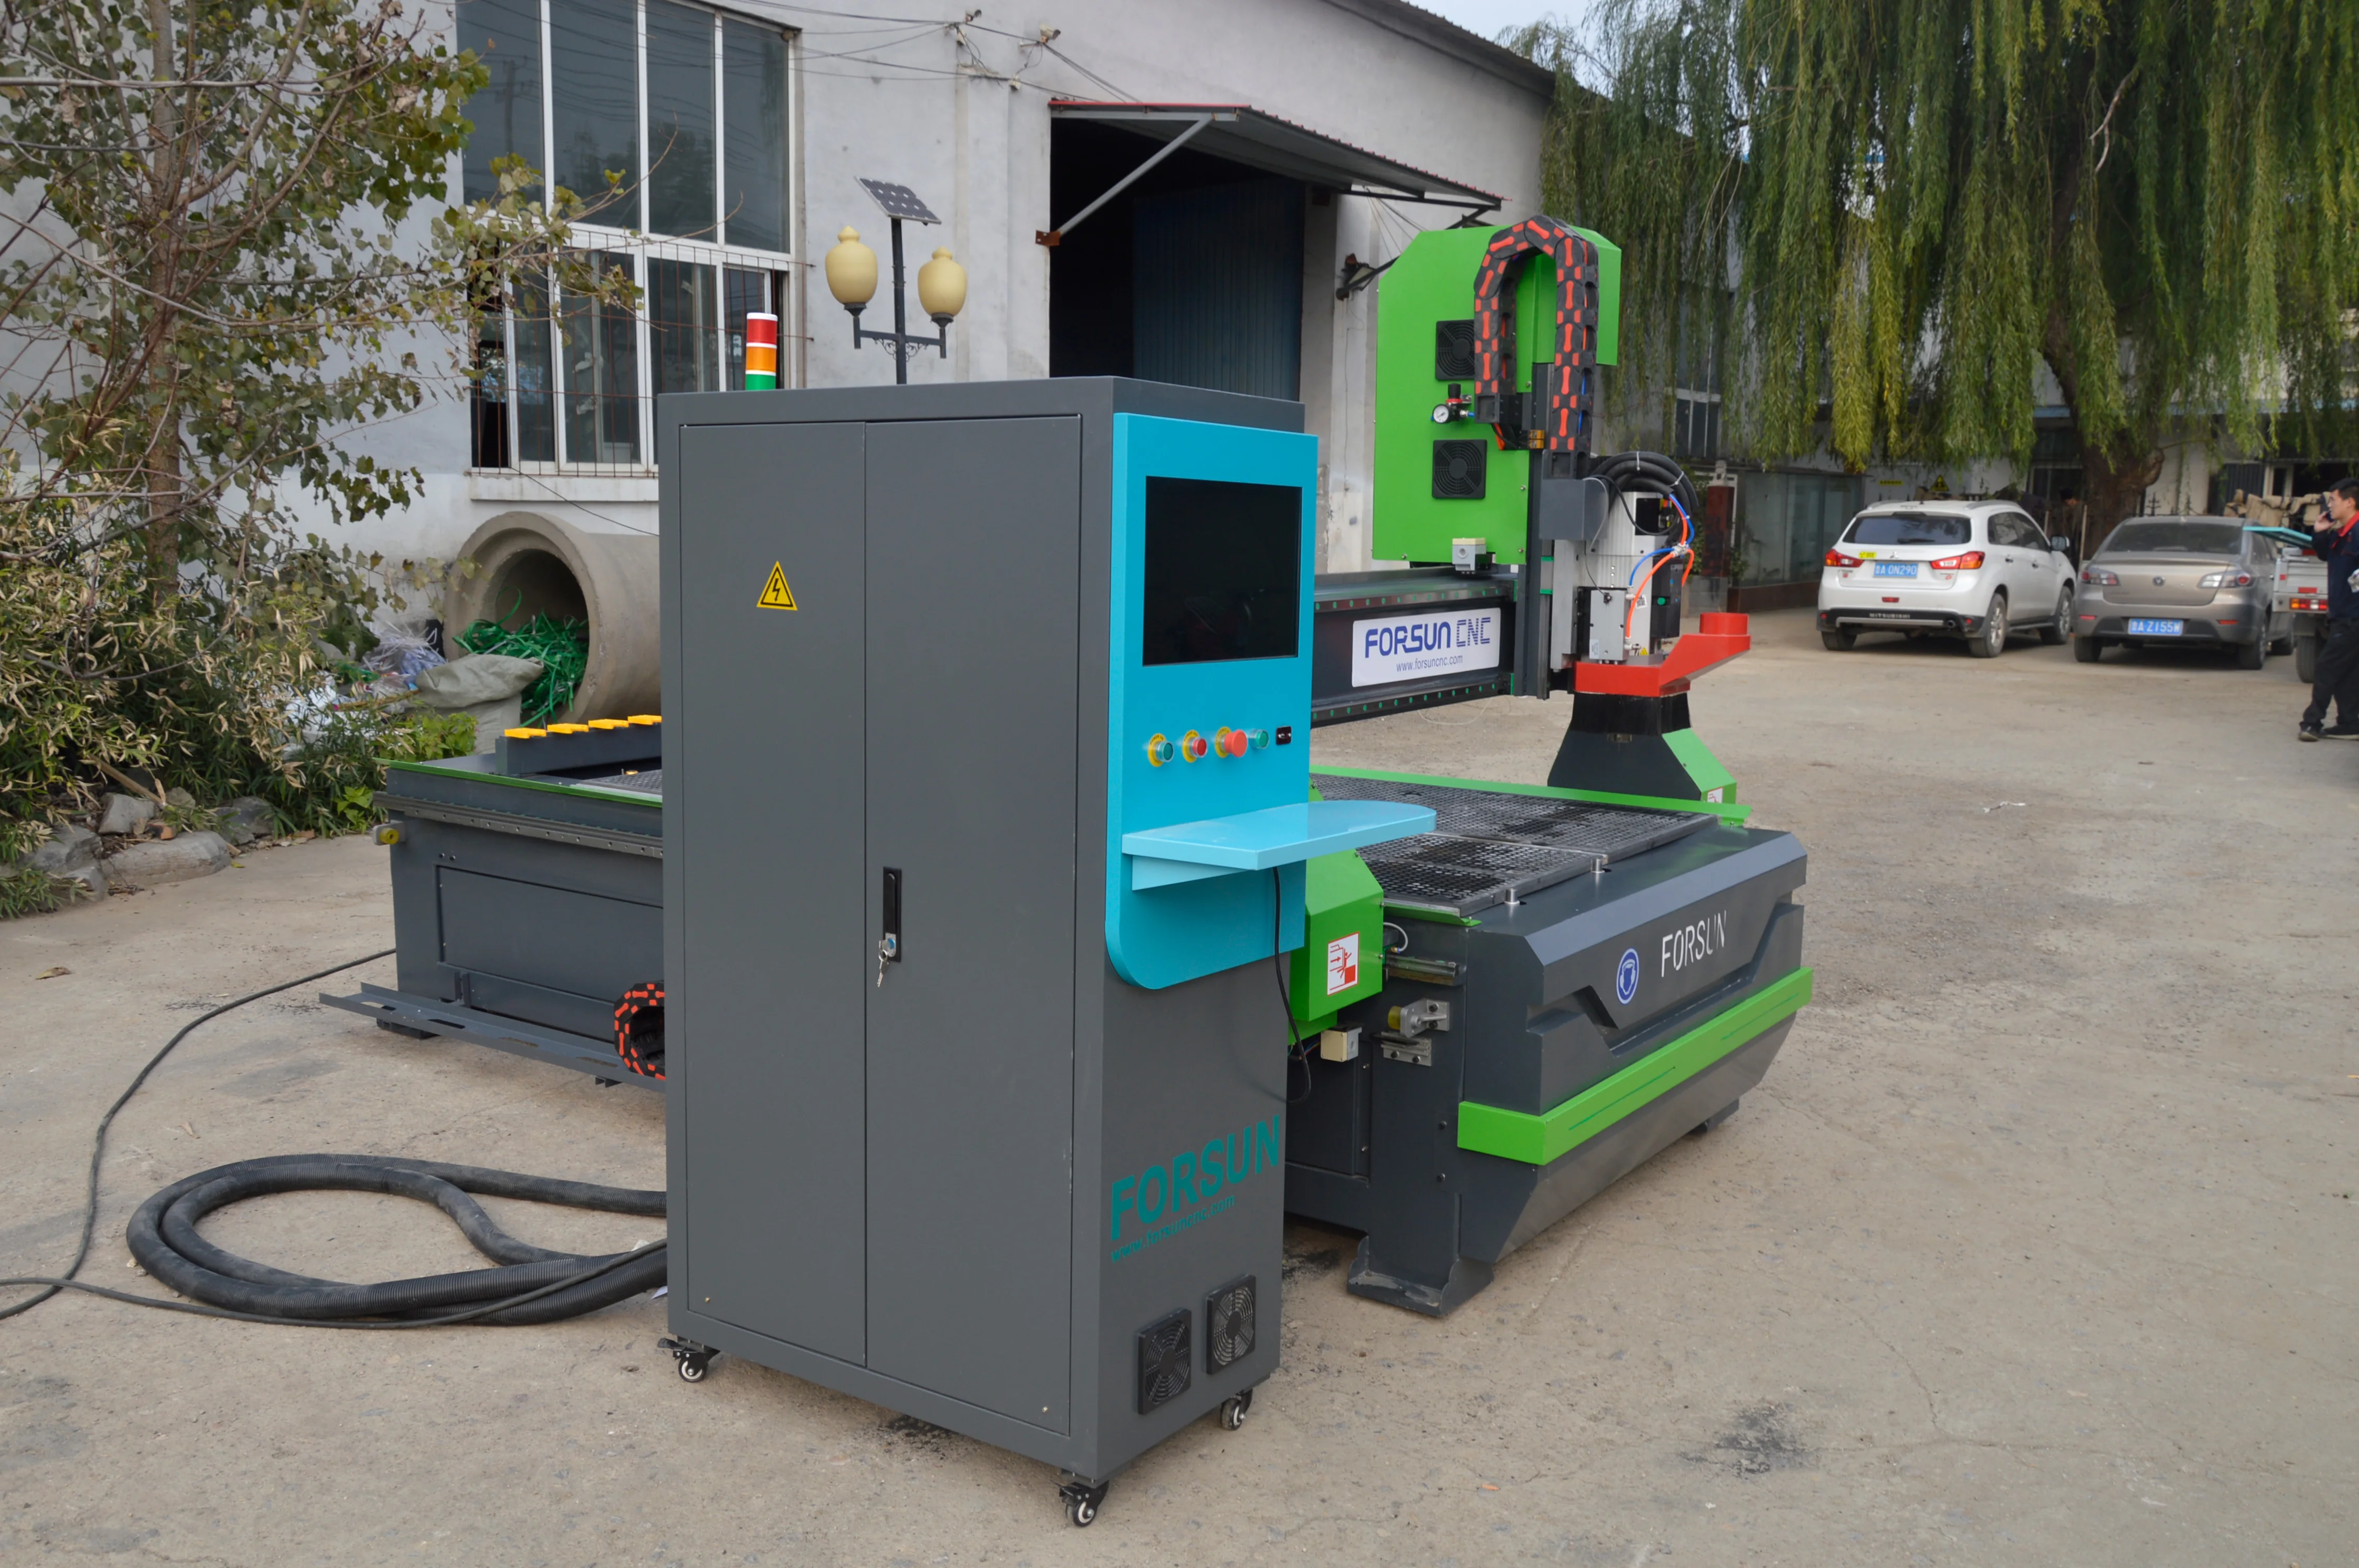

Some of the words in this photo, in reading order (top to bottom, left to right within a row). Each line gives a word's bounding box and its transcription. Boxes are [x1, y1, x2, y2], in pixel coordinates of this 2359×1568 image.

[1365, 621, 1451, 659] FORSUN
[1456, 616, 1491, 648] CNC
[1396, 653, 1463, 673] www.forsuncnc.com
[1661, 909, 1727, 978] FORSUN
[1111, 1114, 1280, 1241] FORSUN
[1110, 1195, 1235, 1263] www.forsuncnc.com
